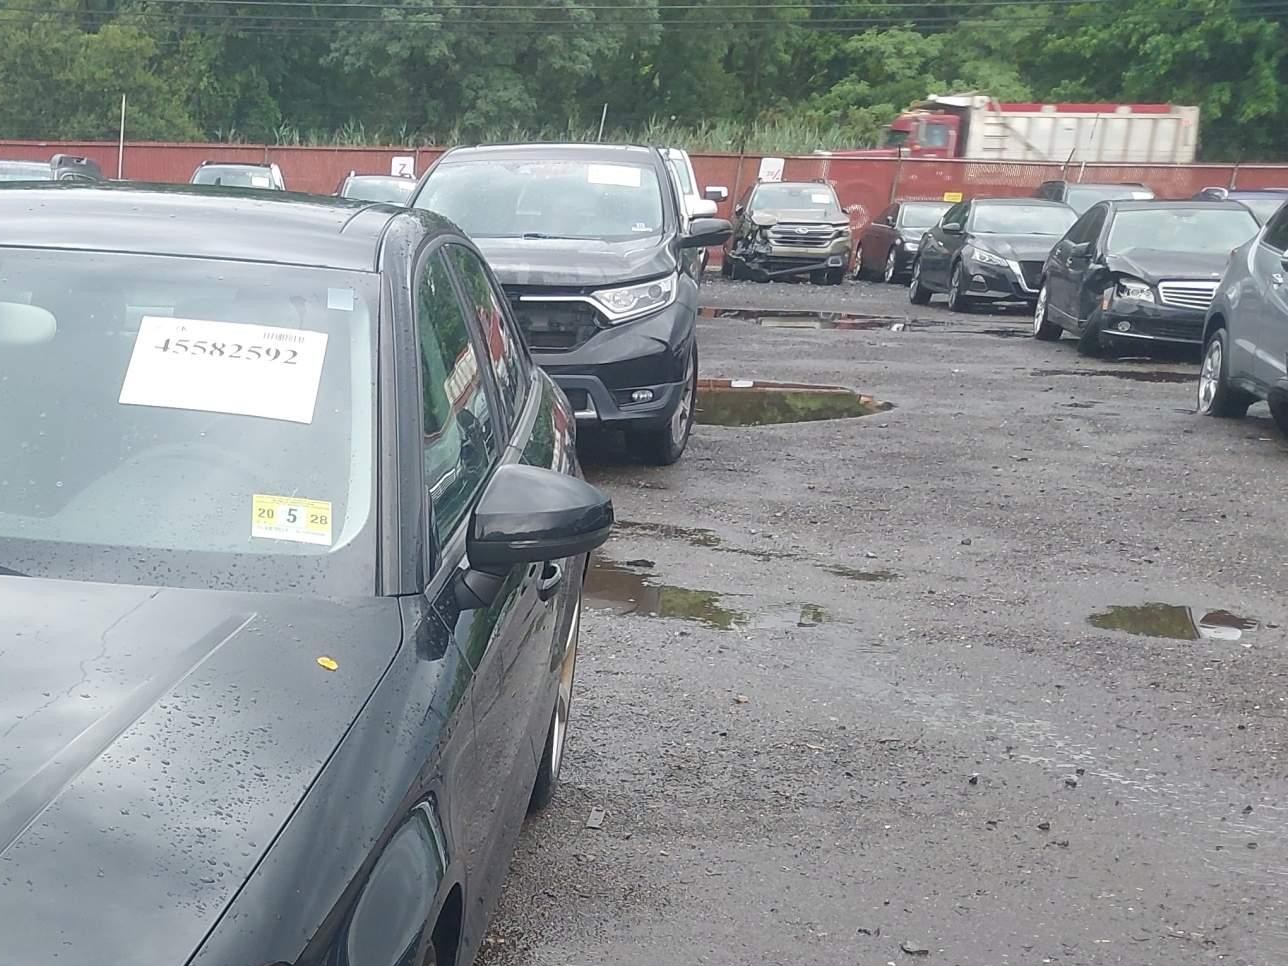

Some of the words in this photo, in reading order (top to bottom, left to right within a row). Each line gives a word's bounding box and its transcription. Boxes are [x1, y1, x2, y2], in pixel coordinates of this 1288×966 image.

[154, 337, 298, 365] 45582592
[258, 508, 274, 519] 20
[286, 508, 298, 523] 5
[310, 514, 328, 525] 28
